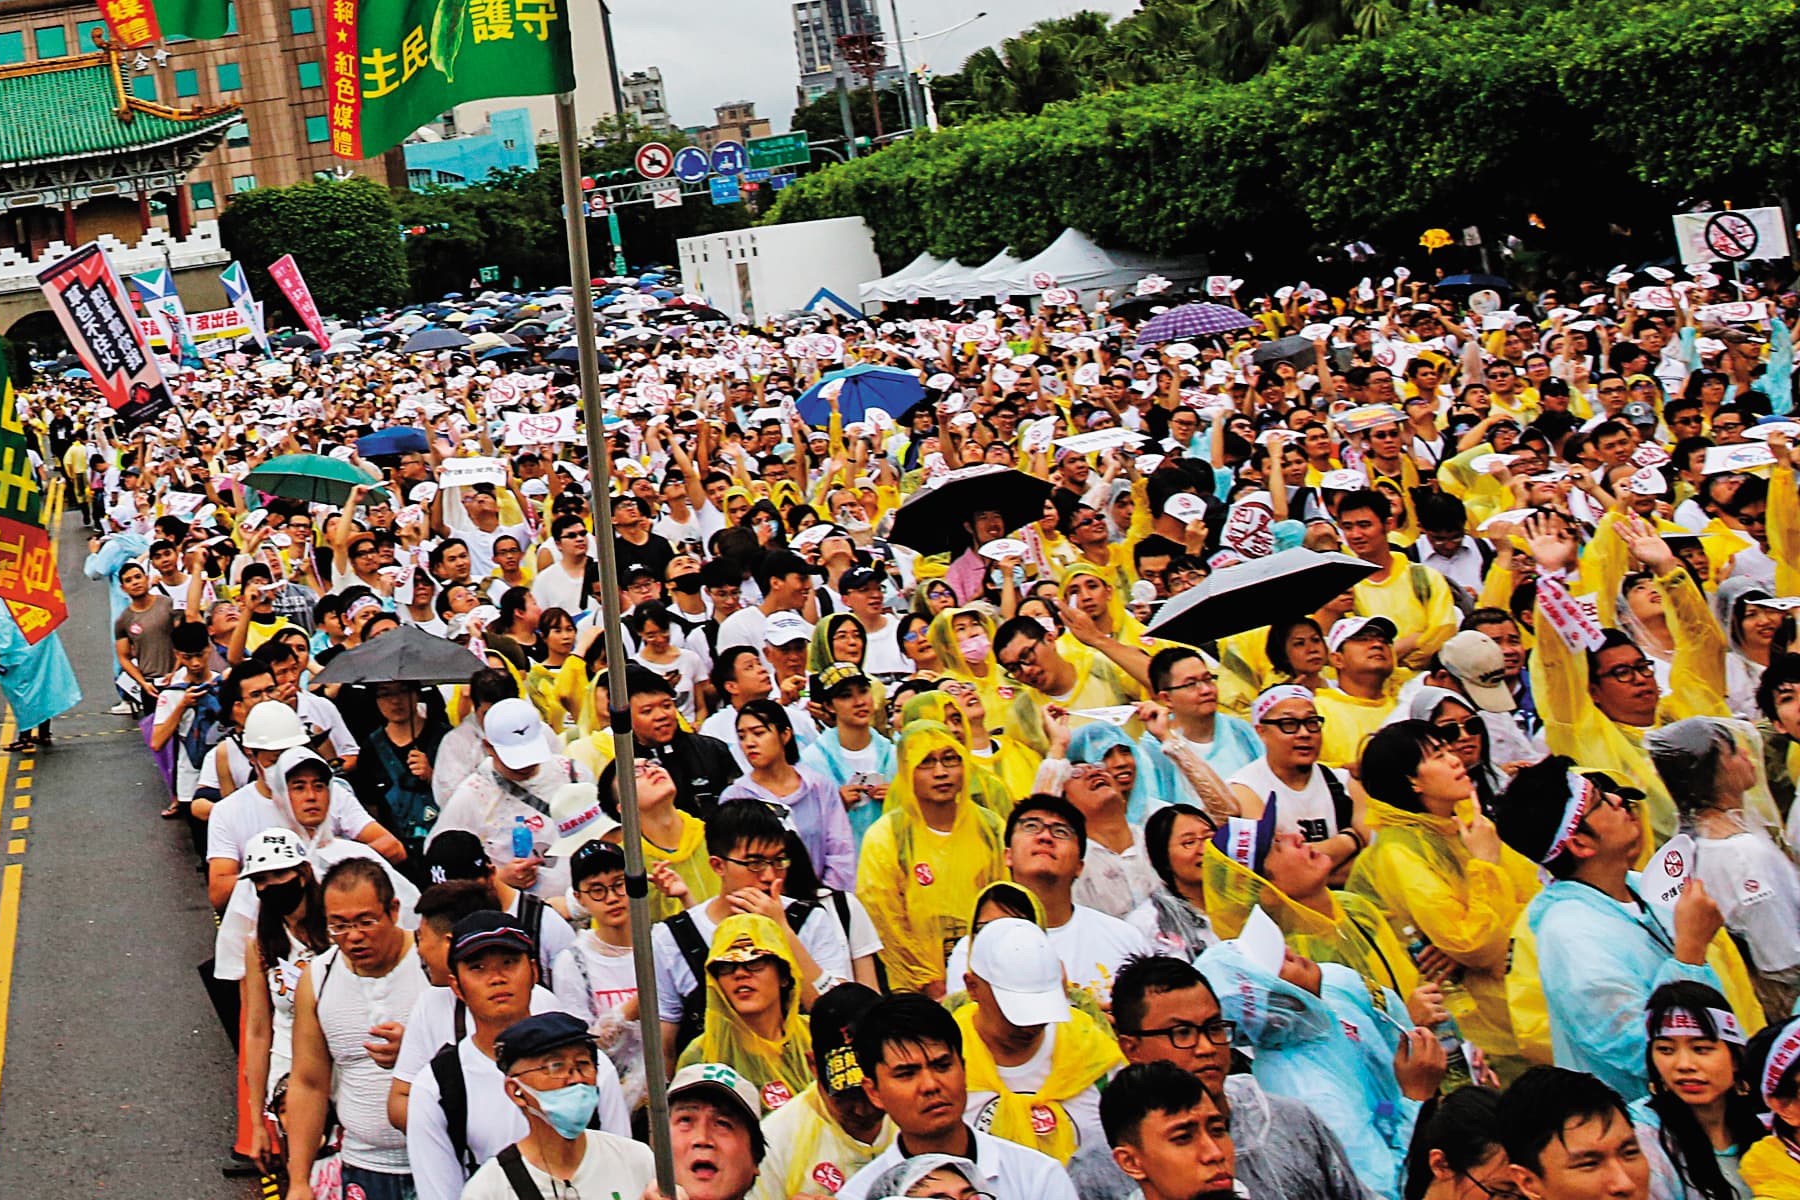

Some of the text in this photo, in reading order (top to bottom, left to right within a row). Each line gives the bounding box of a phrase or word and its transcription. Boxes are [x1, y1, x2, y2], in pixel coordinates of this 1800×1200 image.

[332, 50, 357, 158] 紅色媒體
[196, 311, 245, 331] 滾出台
